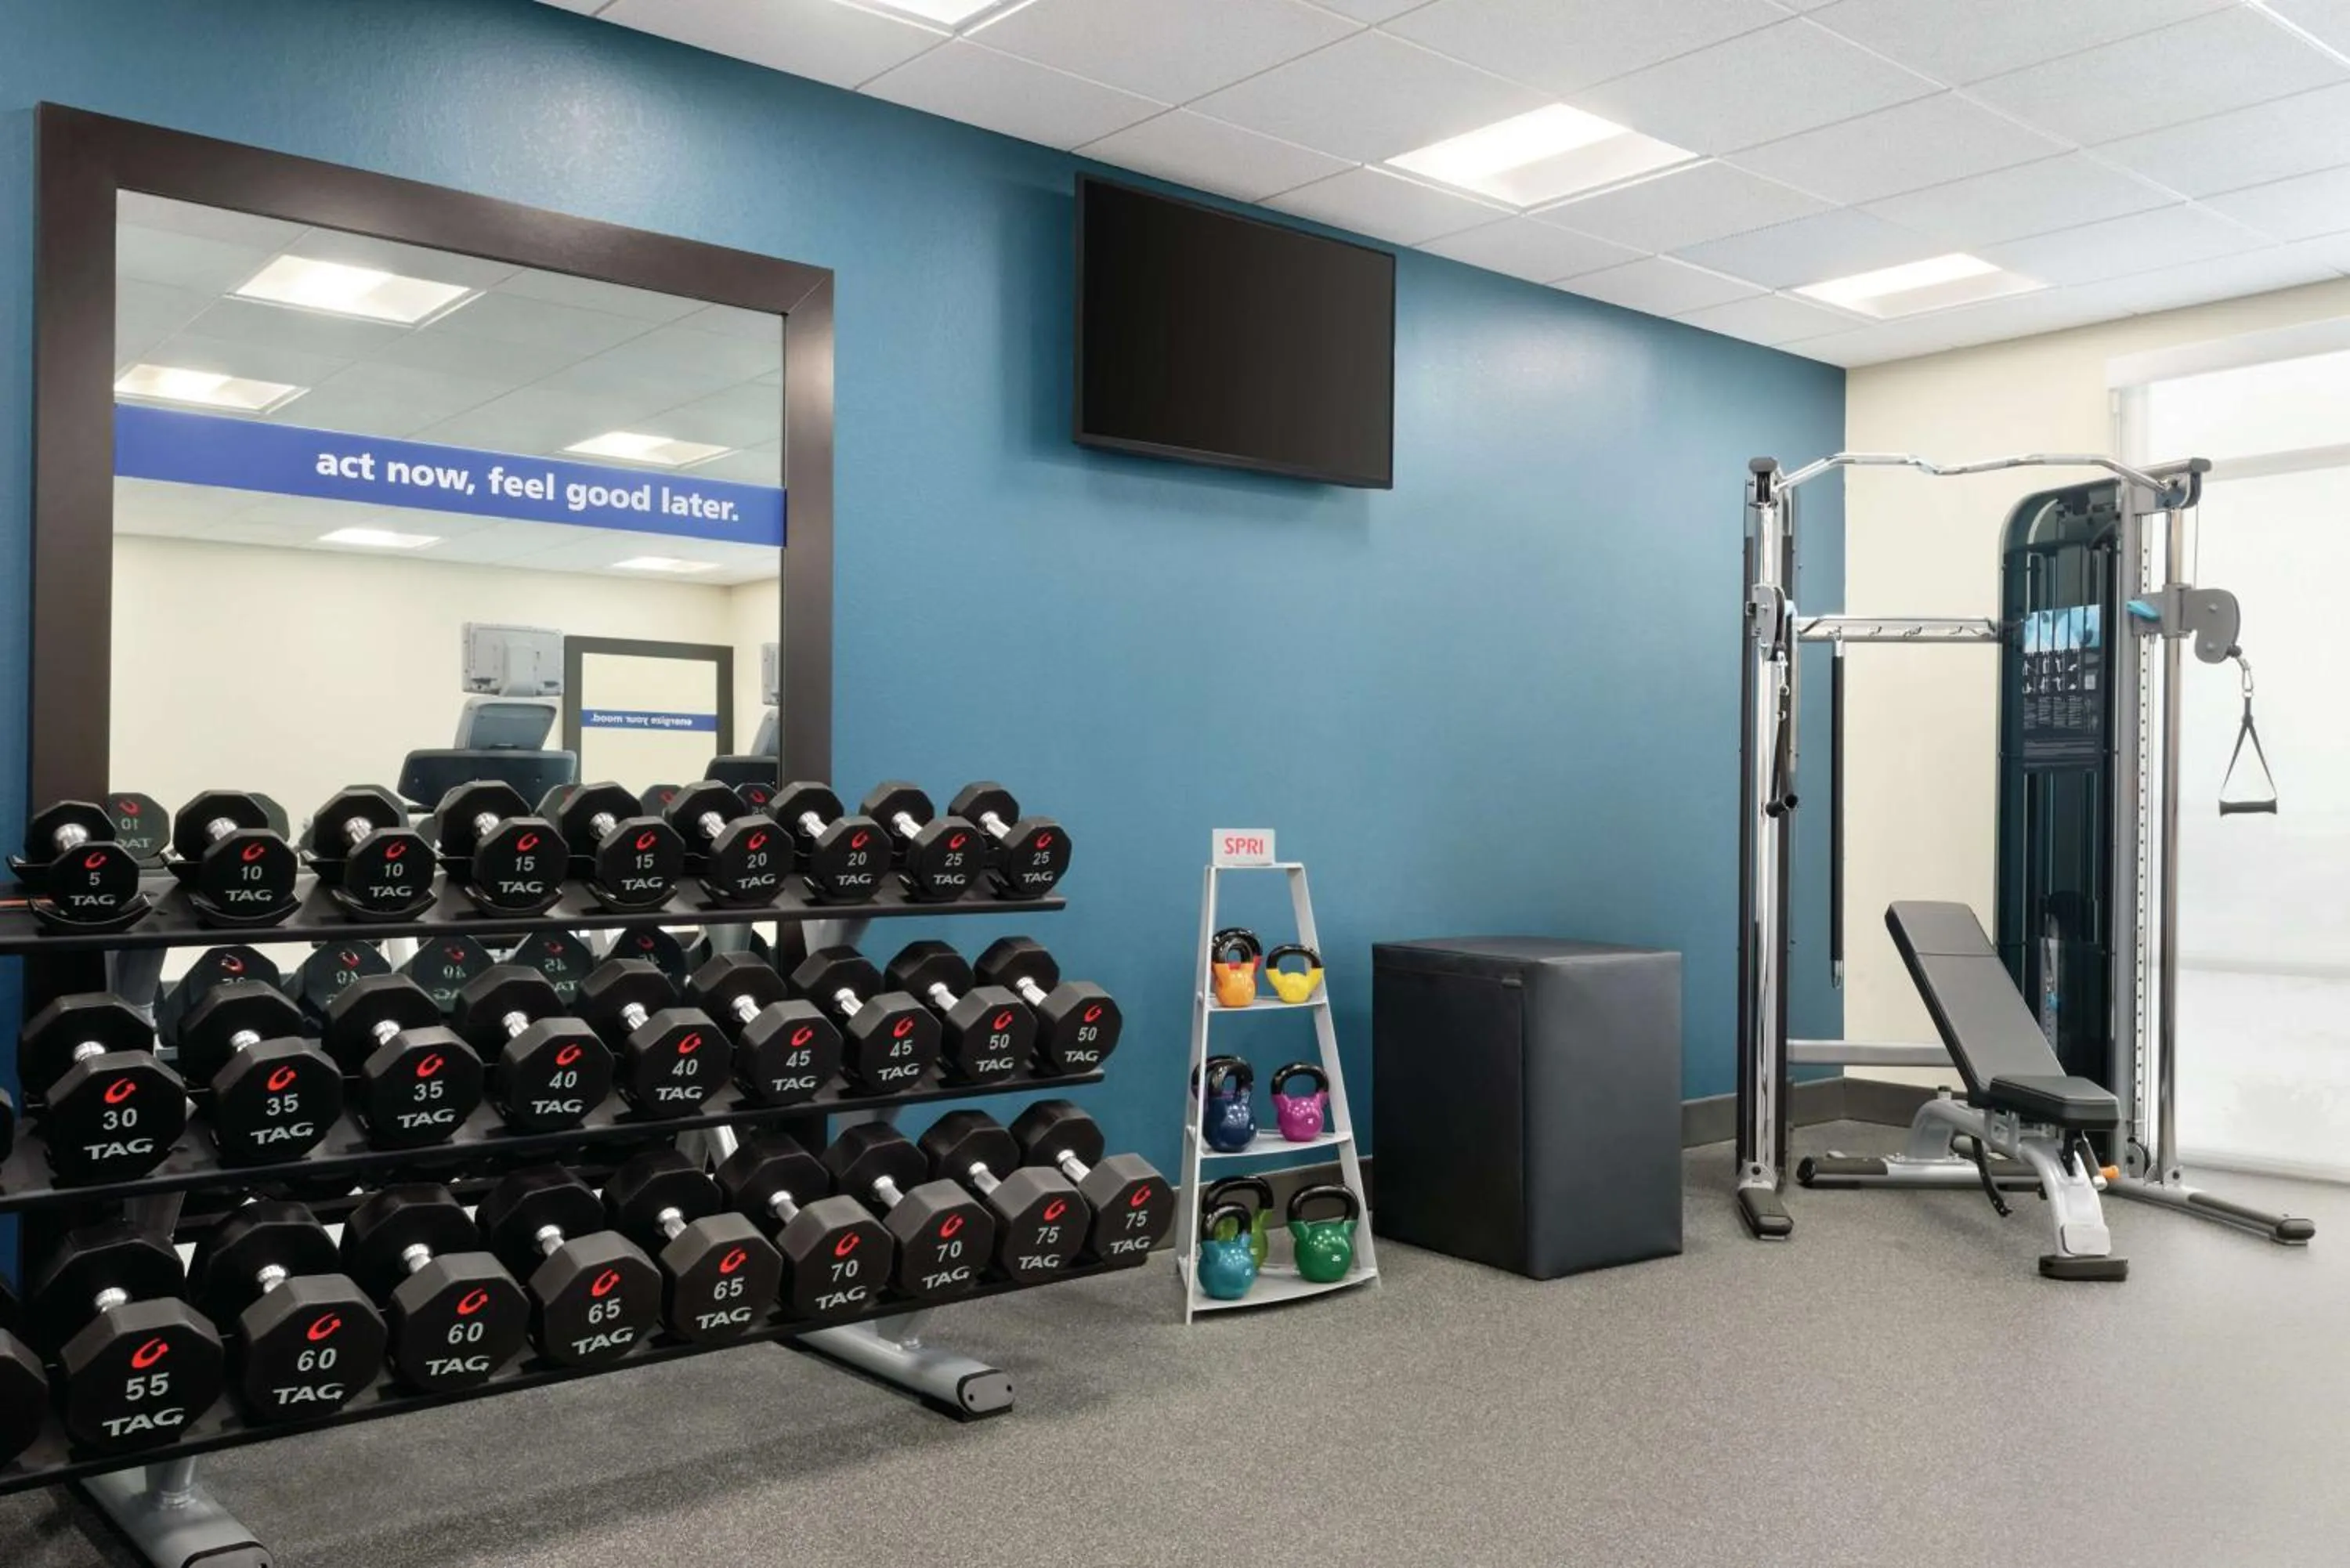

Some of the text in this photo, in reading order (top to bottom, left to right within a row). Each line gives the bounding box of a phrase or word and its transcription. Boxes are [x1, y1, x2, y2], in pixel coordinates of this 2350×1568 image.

[316, 452, 739, 521] act now, feel good later.
[1224, 836, 1264, 856] SPRI
[515, 855, 535, 872] 15
[635, 853, 654, 869] 15
[747, 851, 768, 869] 20
[847, 851, 867, 867] 20
[944, 852, 964, 867] 25
[1032, 851, 1050, 865] 25
[89, 872, 101, 886] 5
[241, 865, 262, 880] 10
[385, 862, 403, 878] 10
[933, 873, 966, 885] TAG
[1022, 870, 1054, 883] TAG
[498, 880, 543, 894] TAG
[621, 876, 663, 891] TAG
[736, 873, 776, 889] TAG
[837, 873, 872, 886] TAG
[69, 894, 116, 906] TAG
[225, 889, 273, 901] TAG
[369, 886, 412, 898] TAG
[989, 1033, 1010, 1050] 50
[1077, 1026, 1097, 1042] 50
[889, 1039, 913, 1057] 45
[1065, 1050, 1099, 1063] TAG
[671, 1058, 698, 1076] 40
[786, 1050, 812, 1068] 45
[976, 1057, 1014, 1072] TAG
[548, 1071, 577, 1089] 40
[877, 1063, 919, 1081] TAG
[413, 1080, 443, 1102] 35
[772, 1075, 816, 1091] TAG
[656, 1086, 703, 1100] TAG
[266, 1093, 299, 1116] 35
[531, 1099, 582, 1115] TAG
[103, 1107, 138, 1130] 30
[397, 1108, 455, 1129] TAG
[250, 1122, 314, 1145] TAG
[83, 1138, 154, 1160] TAG
[1126, 1209, 1148, 1230] 75
[1036, 1226, 1061, 1245] 75
[937, 1240, 963, 1263] 70
[1110, 1236, 1150, 1255] TAG
[831, 1259, 859, 1282] 70
[1018, 1254, 1060, 1270] TAG
[922, 1266, 970, 1289] TAG
[714, 1277, 744, 1300] 65
[815, 1285, 866, 1310] TAG
[588, 1297, 621, 1324] 65
[696, 1307, 752, 1329] TAG
[447, 1321, 483, 1344] 60
[572, 1328, 634, 1355] TAG
[297, 1347, 337, 1371] 60
[425, 1355, 490, 1376] TAG
[125, 1371, 169, 1401] 55
[273, 1382, 343, 1404] TAG
[102, 1407, 184, 1436] TAG
